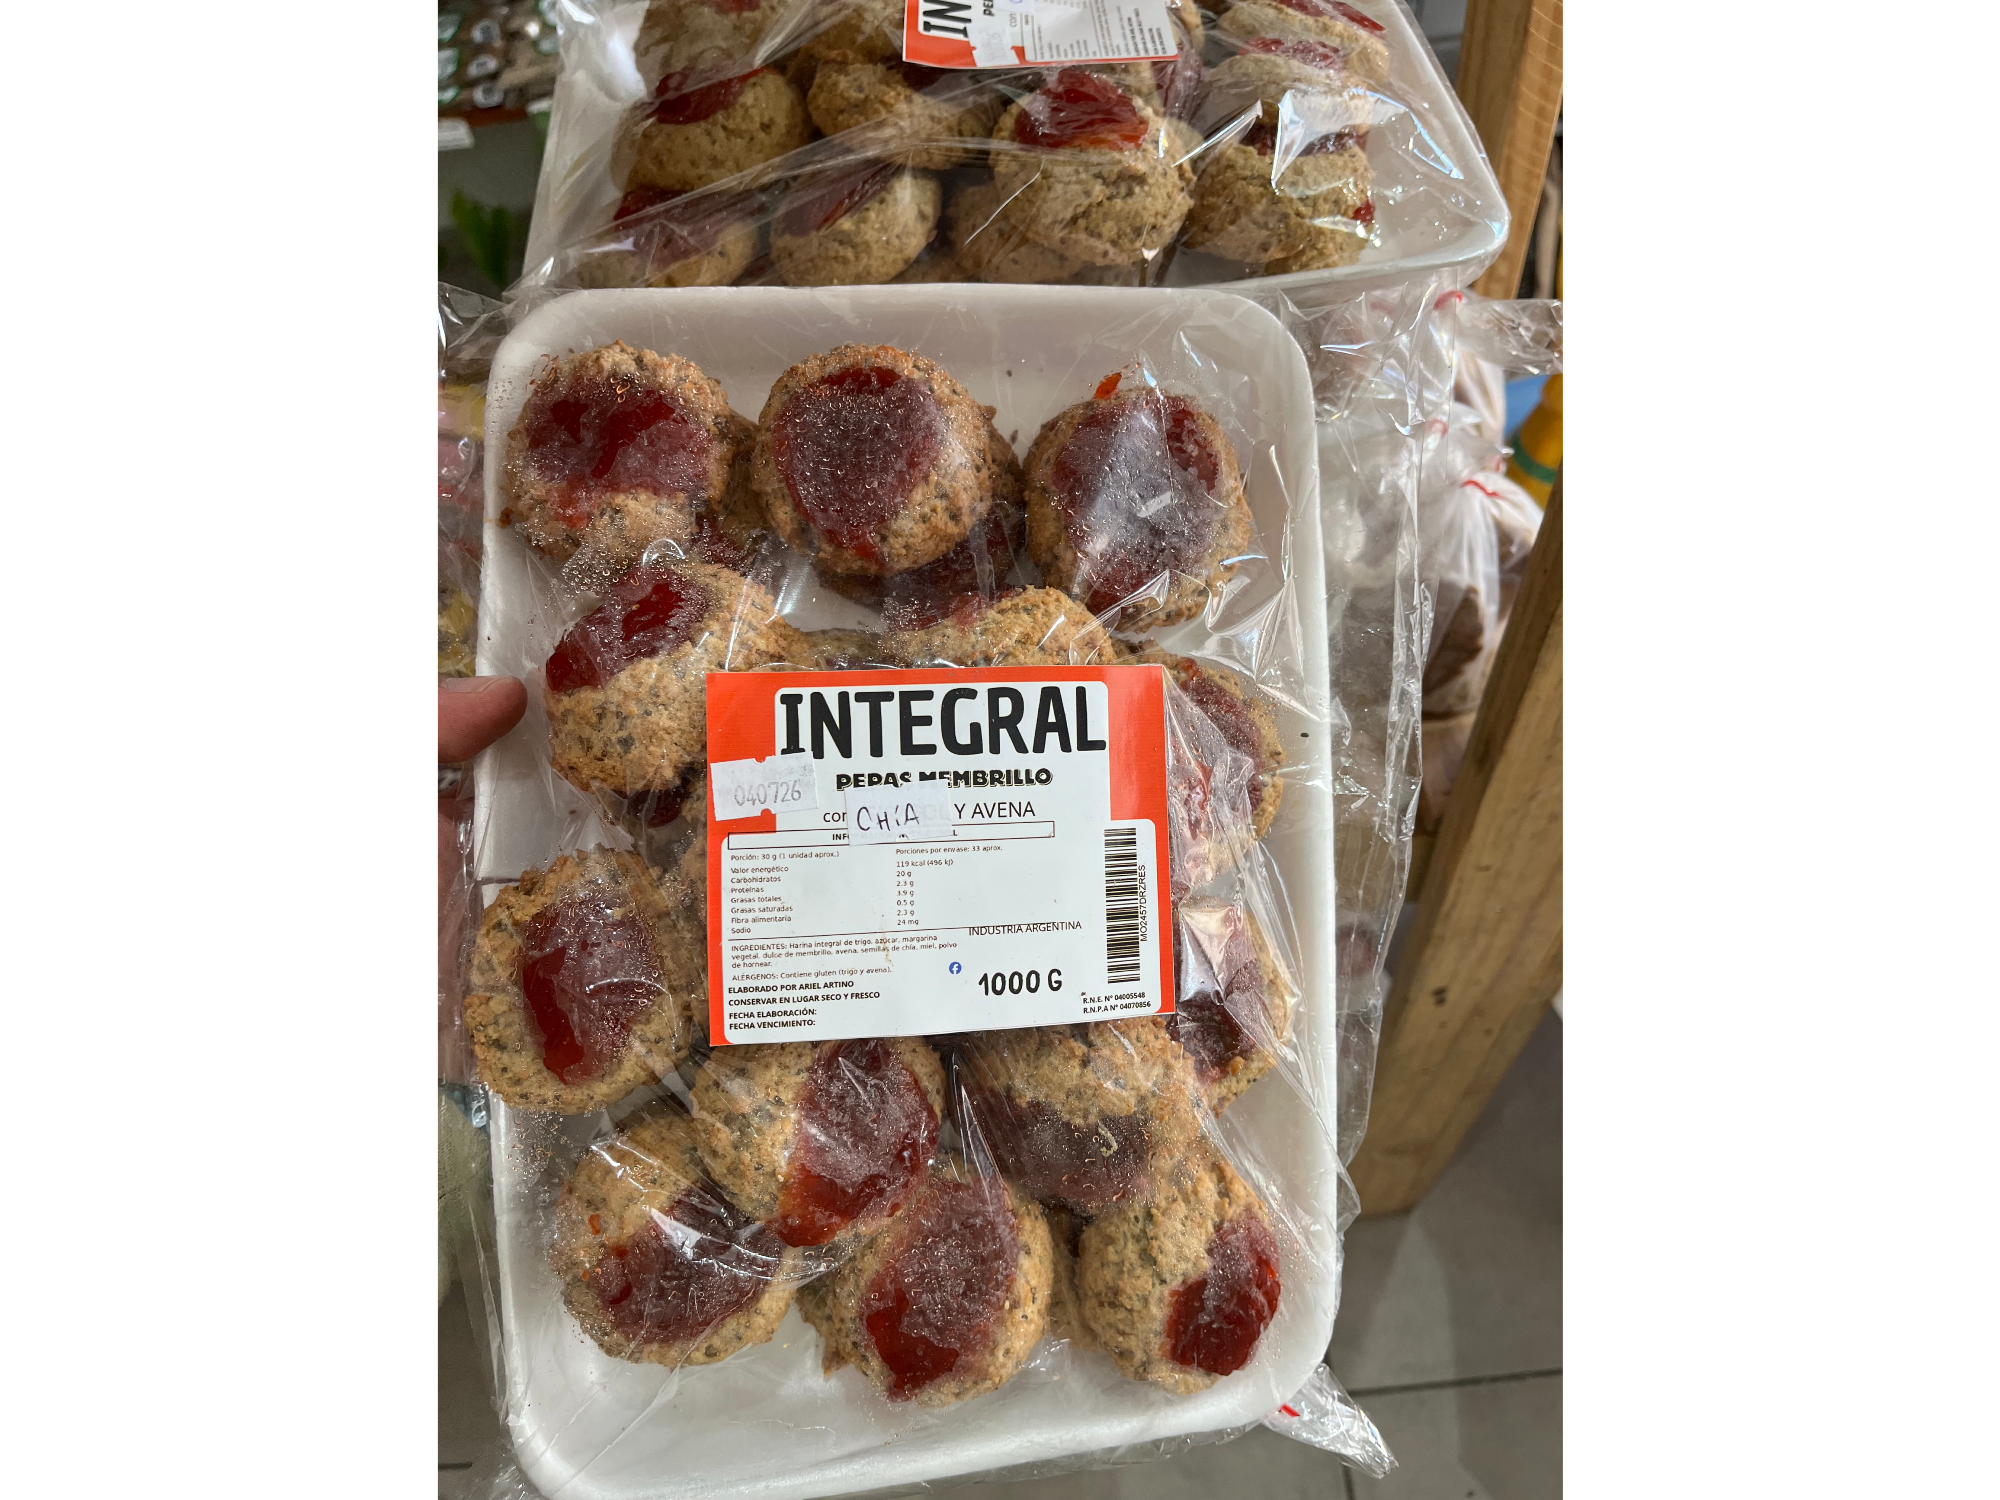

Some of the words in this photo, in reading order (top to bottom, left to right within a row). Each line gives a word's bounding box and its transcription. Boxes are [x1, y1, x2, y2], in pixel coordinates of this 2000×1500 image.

[780, 686, 1106, 759] INTEGRAL
[836, 772, 911, 791] PEPAS
[919, 768, 1052, 788] MEMBRILLO
[954, 803, 966, 819] Y
[971, 801, 1036, 819] AVENA
[814, 851, 839, 859] aprox.)
[968, 925, 1023, 936] INDUSTRIA
[1025, 921, 1082, 933] ARGENTINA
[731, 943, 788, 952] INGREDIENTES:
[814, 940, 841, 948] integral
[732, 972, 778, 981] ALÉRGENOS:
[814, 970, 836, 979] gluten
[978, 970, 1040, 996] 1000
[1048, 968, 1062, 991] G
[728, 985, 778, 994] ELABORADO
[729, 997, 777, 1006] CONSERVAR
[792, 995, 820, 1003] LUGAR
[757, 1007, 817, 1018] ELABORACIÓN:
[1083, 1005, 1108, 1014] R.N.P.A
[757, 1019, 816, 1029] VENCIMIENTO:
